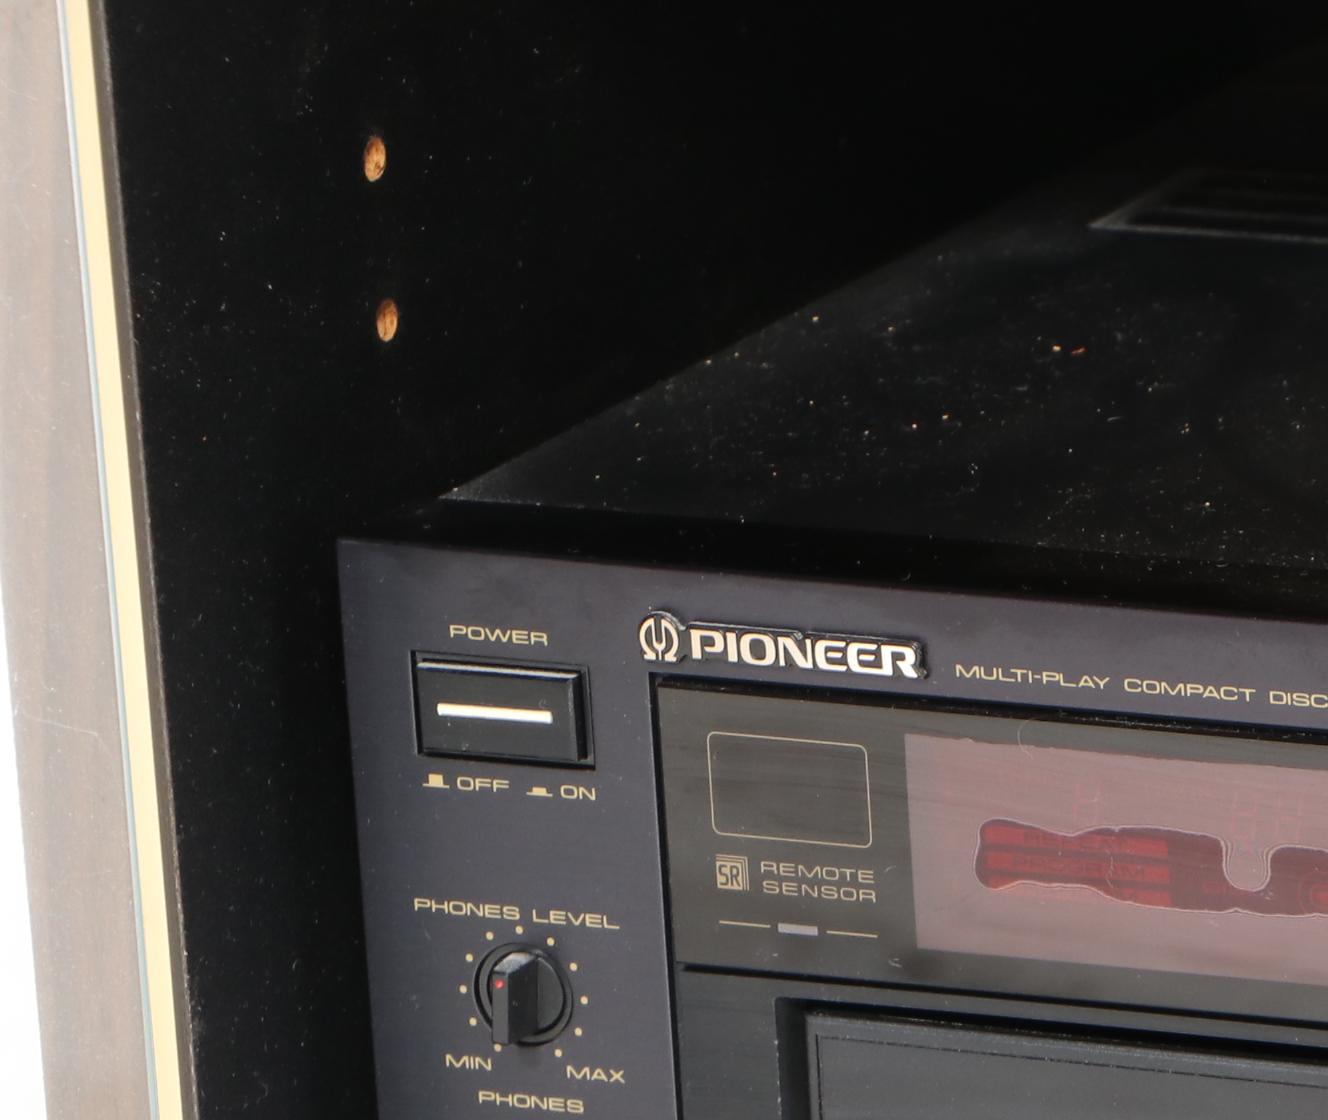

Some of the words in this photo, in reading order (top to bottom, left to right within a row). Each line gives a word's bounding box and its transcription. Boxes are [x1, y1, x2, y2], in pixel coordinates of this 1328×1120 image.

[449, 624, 548, 646] POWER
[689, 629, 918, 679] PIONEER
[955, 664, 1110, 690] MULTI-PLAY
[1123, 678, 1256, 702] COMPACT
[1269, 690, 1328, 709] DISC
[456, 776, 509, 793] OFF
[560, 785, 596, 801] ON
[760, 861, 875, 887] REMOTE
[762, 878, 877, 903] SENSOR
[414, 898, 521, 921] PHONES
[532, 909, 620, 930] LEVEL
[445, 1054, 492, 1071] MIN
[566, 1065, 625, 1084] MAX
[478, 1090, 585, 1114] PHONES
